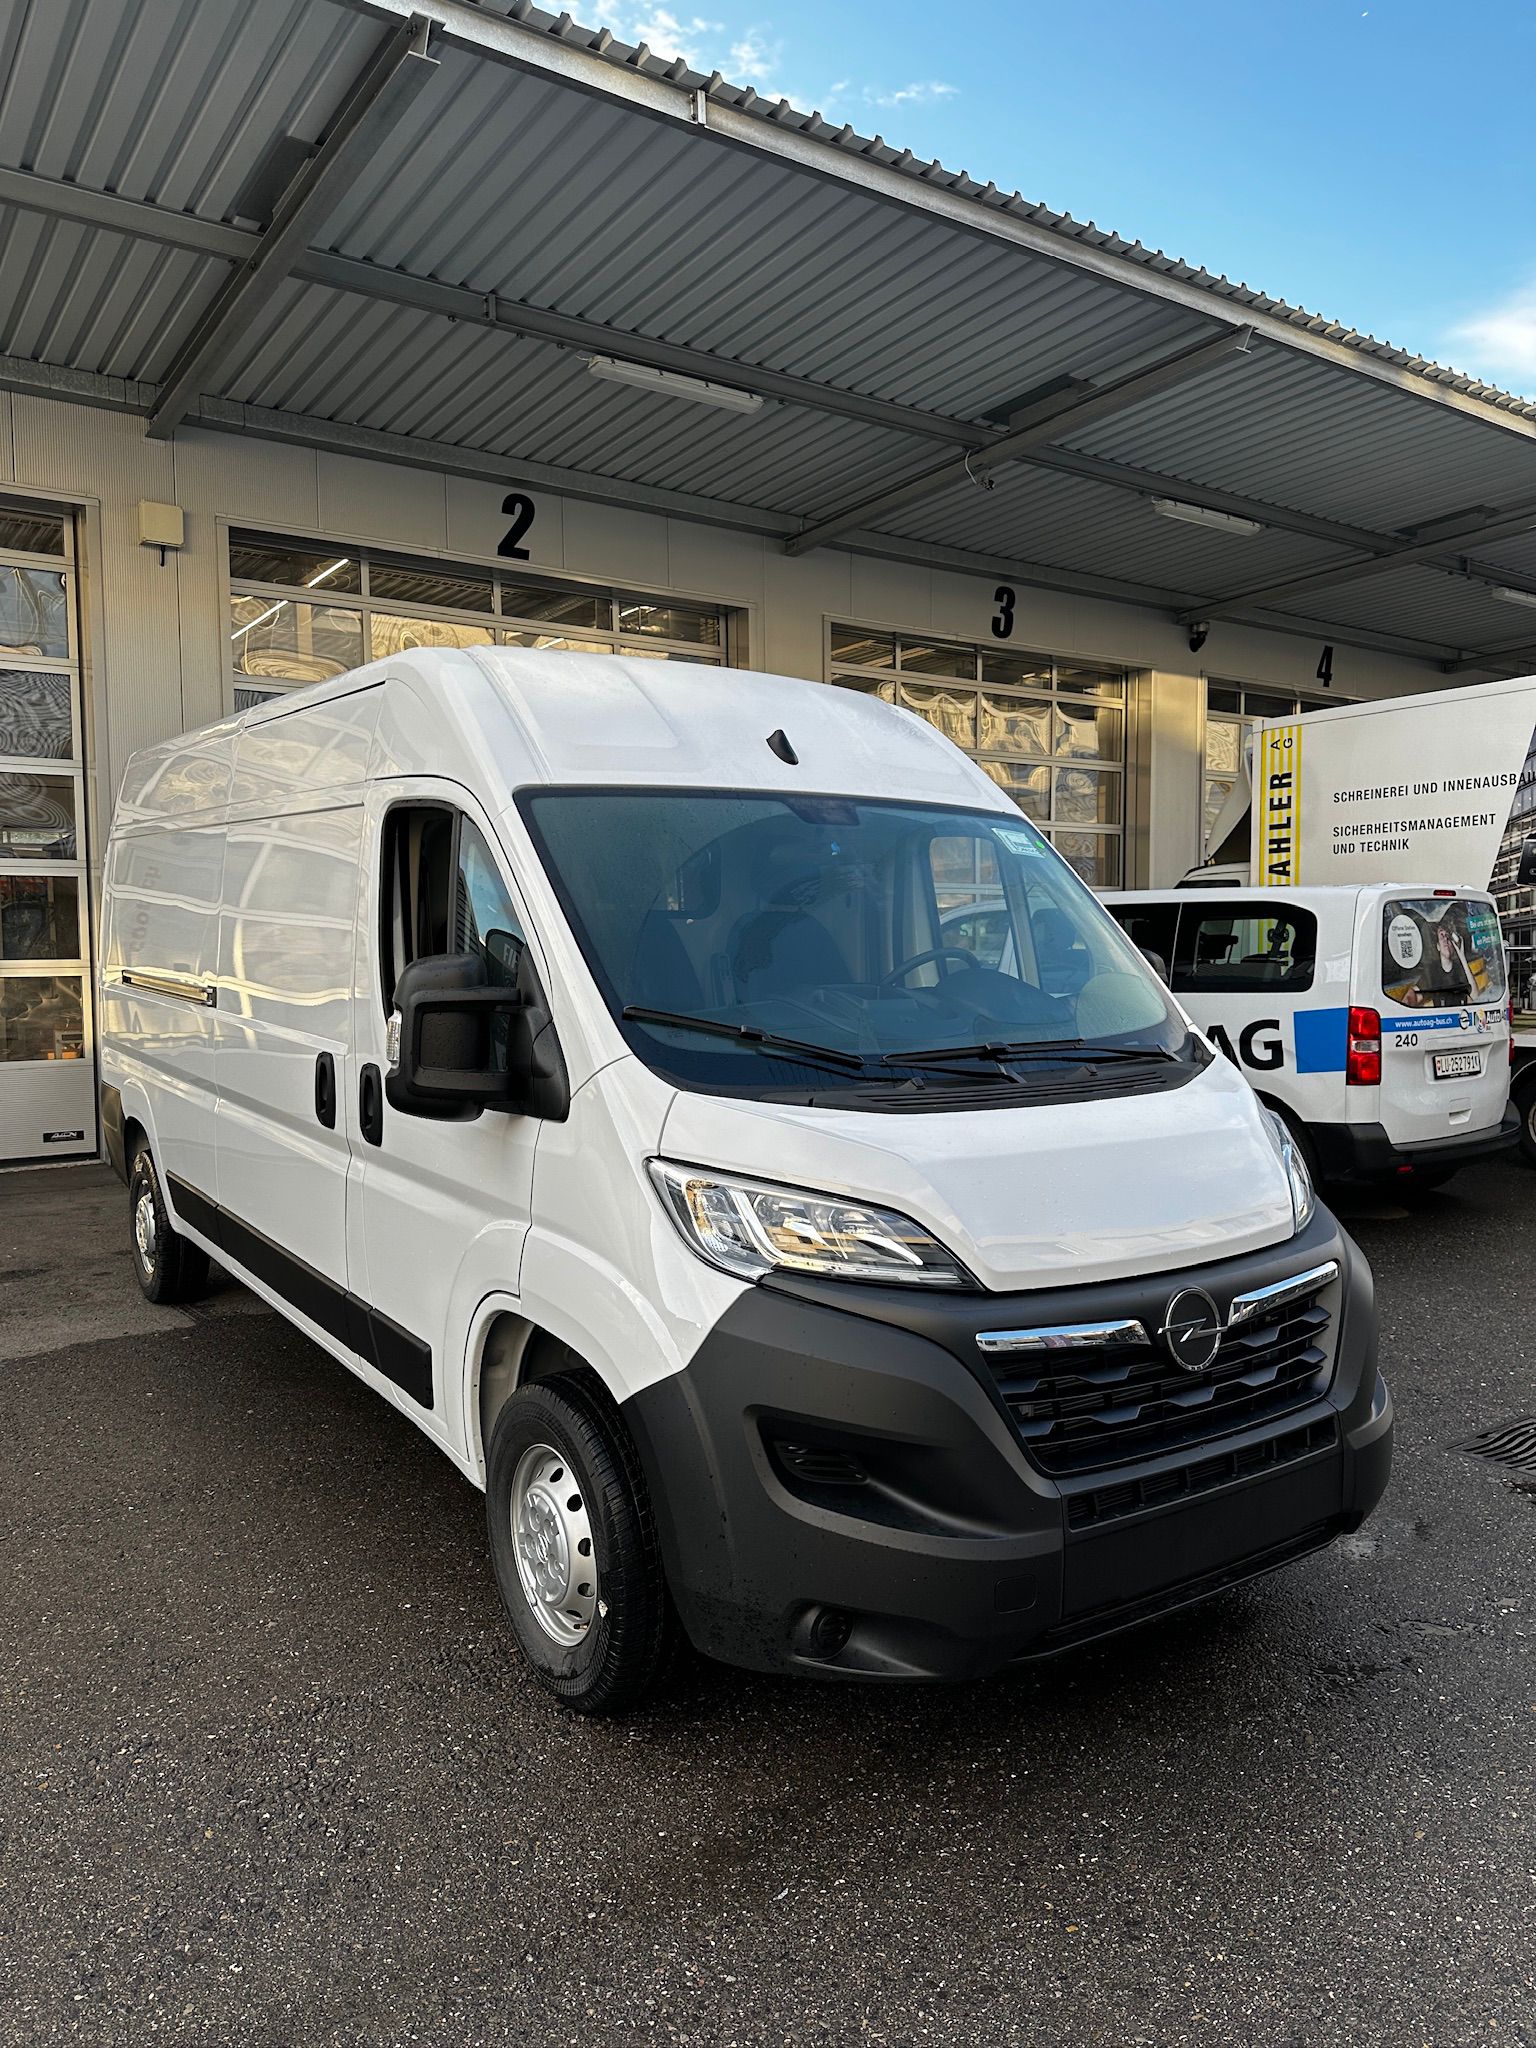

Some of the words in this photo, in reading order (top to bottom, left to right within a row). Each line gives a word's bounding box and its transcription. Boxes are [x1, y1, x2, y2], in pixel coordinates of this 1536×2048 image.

[497, 493, 536, 560] 2
[991, 586, 1016, 639] 3
[1316, 645, 1334, 688] 4
[1333, 785, 1408, 803] SCHREINEREI
[1413, 782, 1438, 795] UND
[1268, 772, 1293, 887] AHLER
[1333, 813, 1496, 837] SICHERHEITSMANAGEMENT
[1333, 843, 1355, 855] UND
[1360, 838, 1410, 853] TECHNIK
[1394, 1017, 1453, 1028] www.autoag-bus.ch
[1206, 1018, 1284, 1071] AG
[1395, 1033, 1418, 1048] 240
